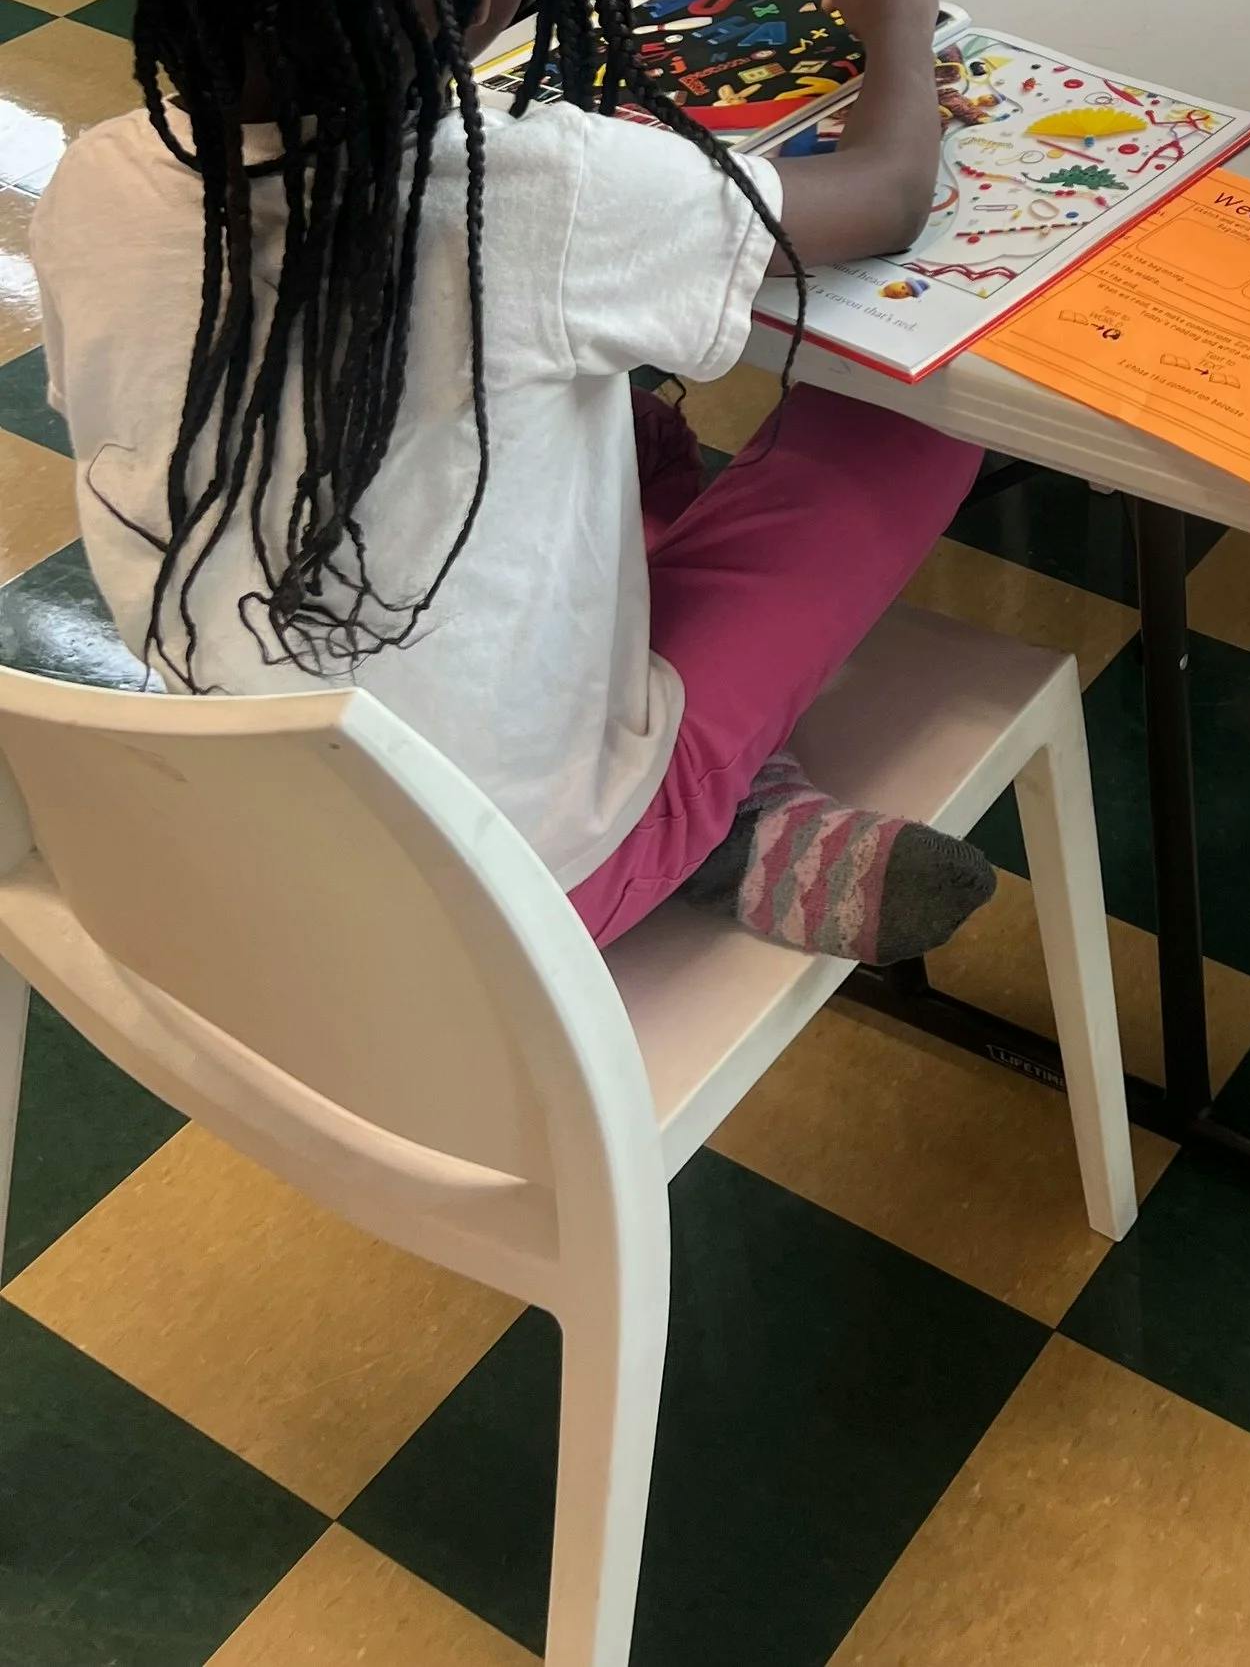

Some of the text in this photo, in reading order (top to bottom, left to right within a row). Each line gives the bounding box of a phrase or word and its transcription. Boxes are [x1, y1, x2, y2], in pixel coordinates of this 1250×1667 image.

[1121, 265, 1134, 273] the
[1098, 283, 1117, 294] When
[825, 292, 864, 311] crayon
[863, 306, 893, 324] that's
[1101, 306, 1121, 317] Text
[1206, 351, 1225, 362] Text
[1150, 374, 1166, 383] this
